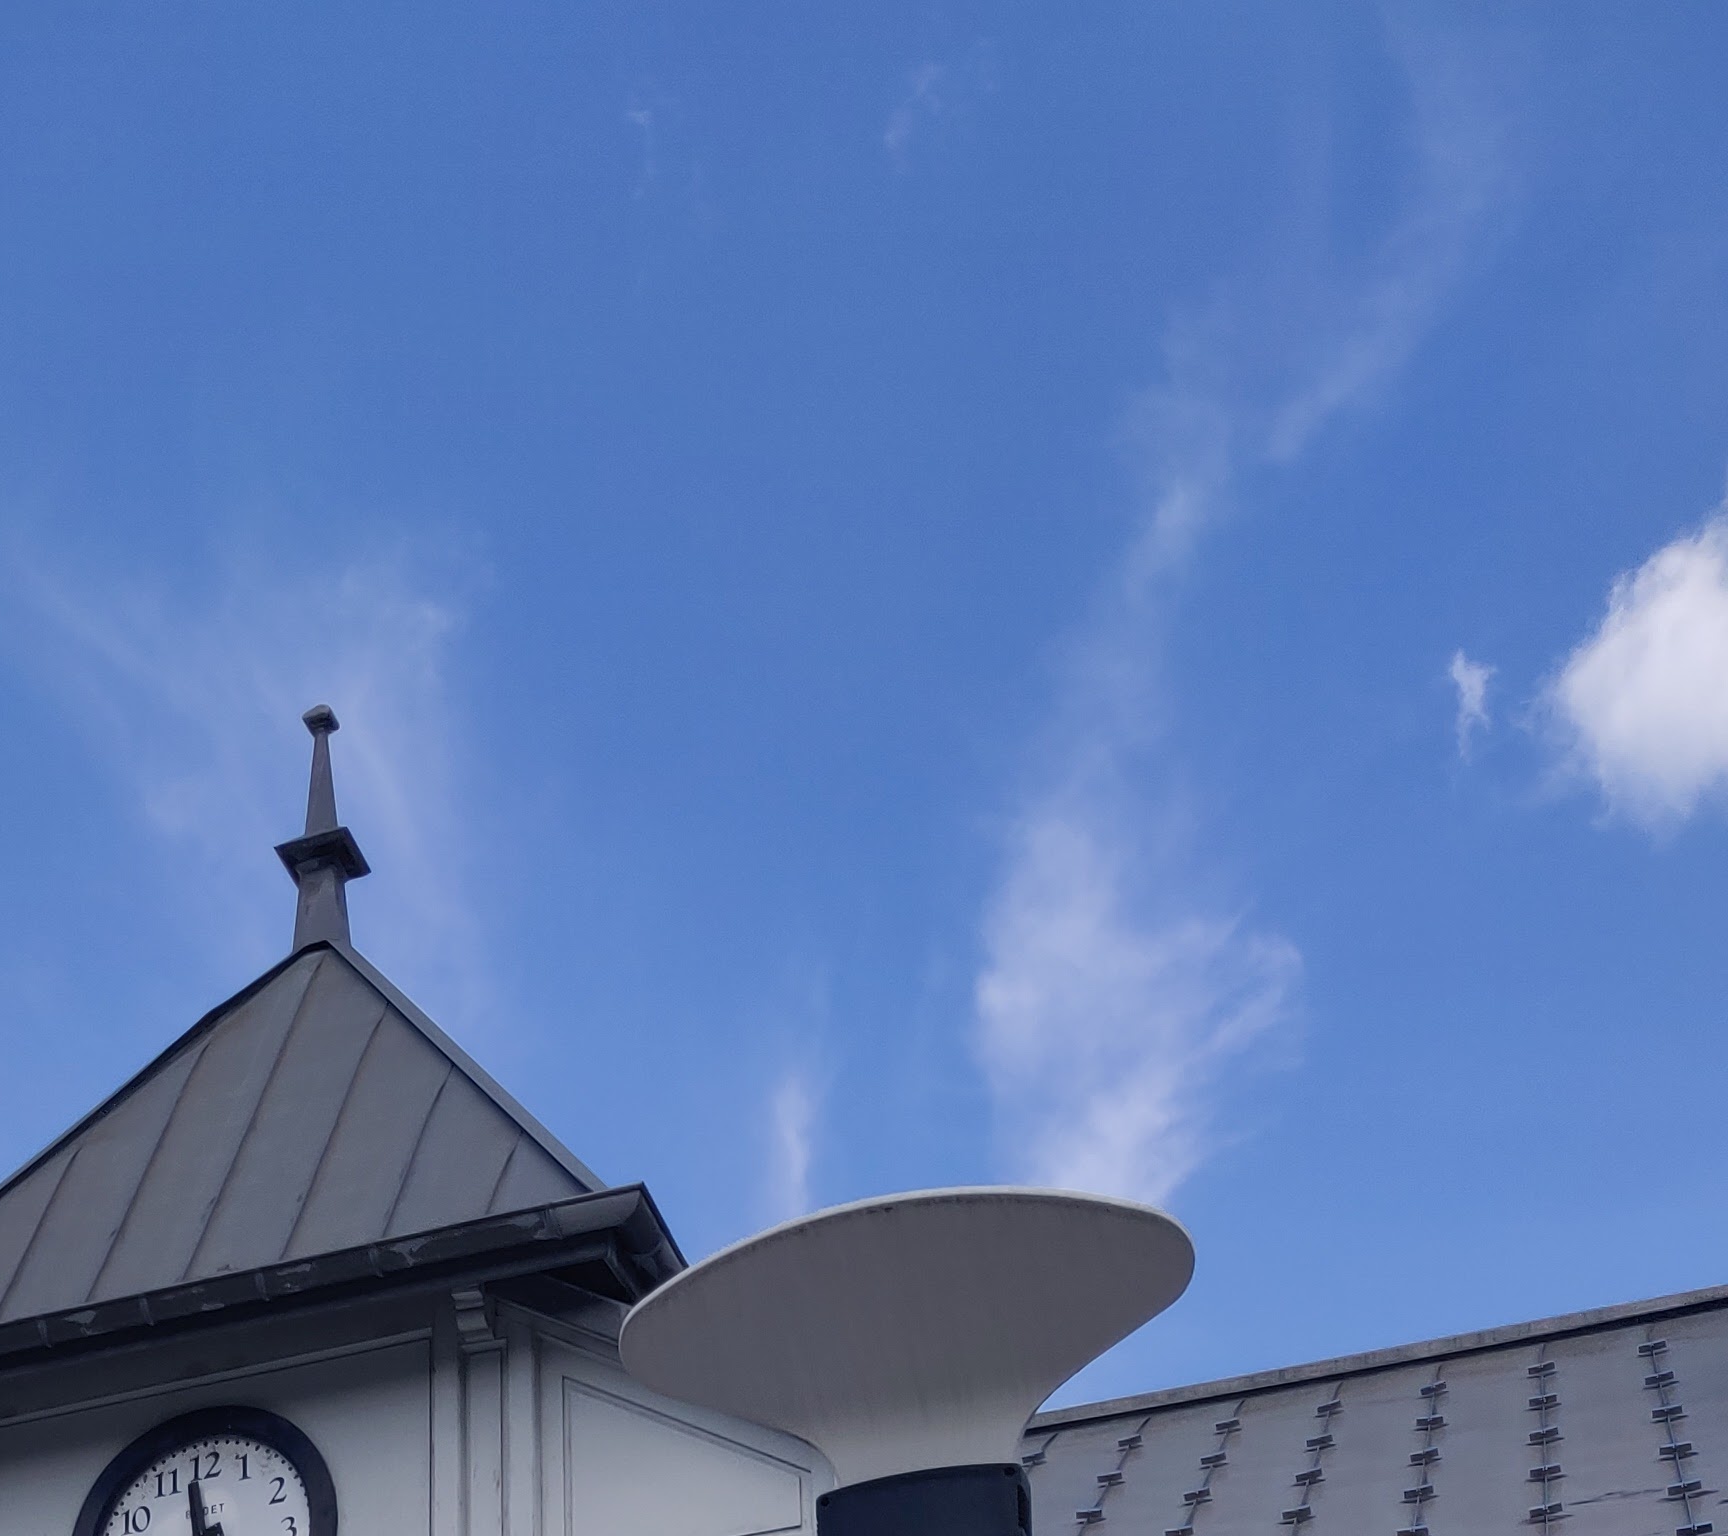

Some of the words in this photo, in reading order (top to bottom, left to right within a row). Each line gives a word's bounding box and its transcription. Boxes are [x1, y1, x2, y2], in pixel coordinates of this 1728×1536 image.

[189, 1451, 222, 1482] 12
[234, 1453, 252, 1481] 1
[153, 1468, 183, 1499] 11
[268, 1476, 287, 1506] 2
[120, 1505, 151, 1536] 10
[185, 1502, 225, 1520] BDET
